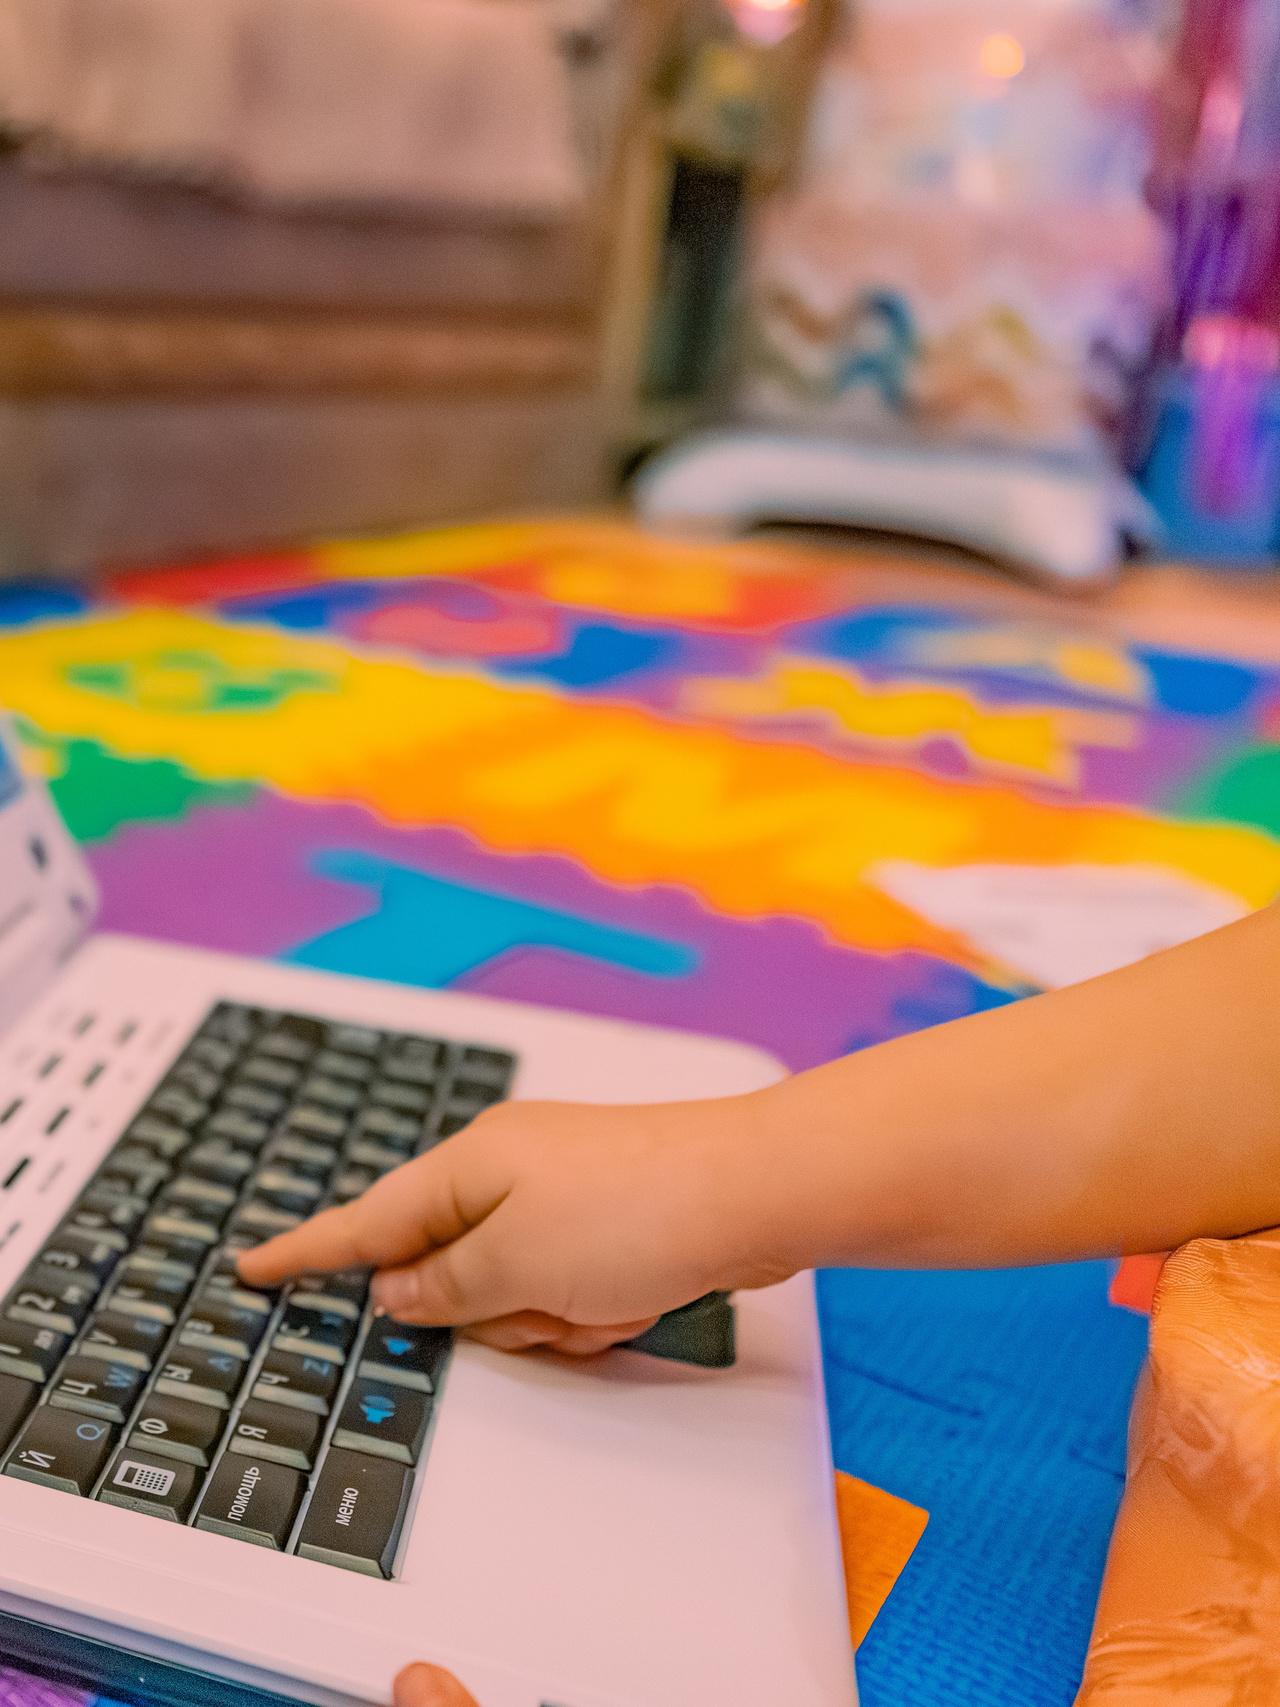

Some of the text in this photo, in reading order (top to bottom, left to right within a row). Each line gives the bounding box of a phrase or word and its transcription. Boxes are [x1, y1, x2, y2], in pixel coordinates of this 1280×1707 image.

[59, 1378, 97, 1395] Ц
[76, 1423, 107, 1441] Q
[138, 1417, 168, 1435] Ф
[237, 1423, 268, 1440] Я
[18, 1450, 56, 1468] Й
[227, 1466, 261, 1522] помощь
[335, 1487, 360, 1526] меню
